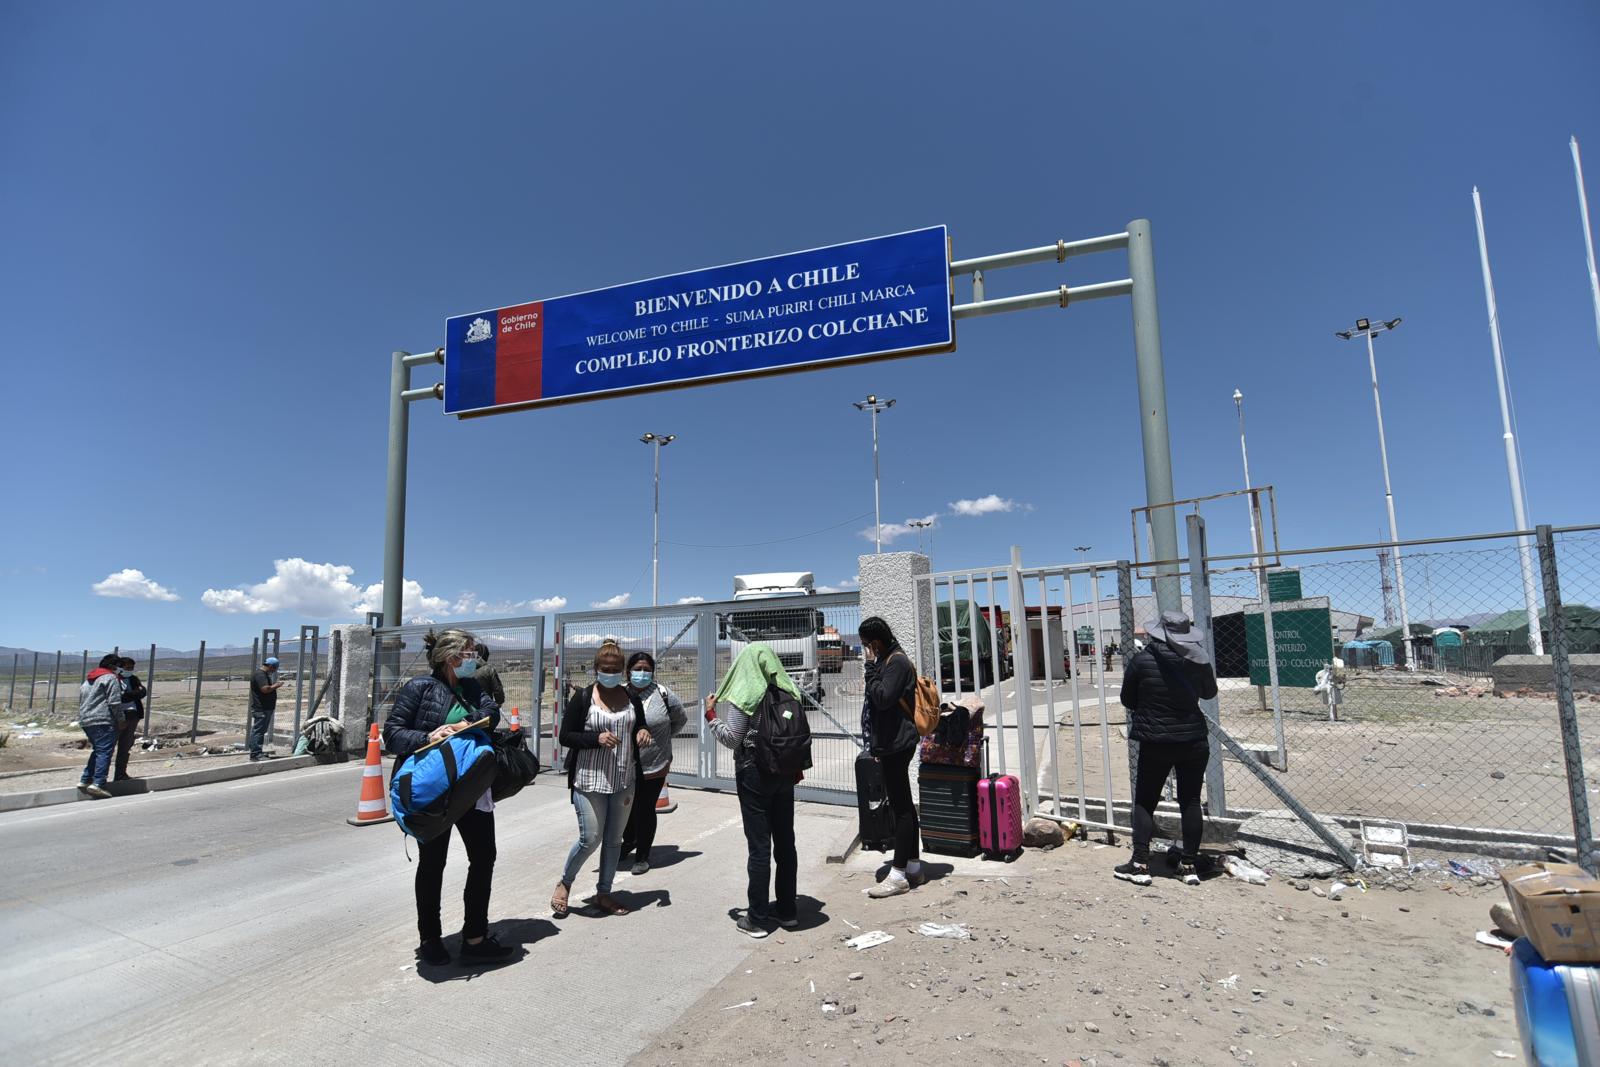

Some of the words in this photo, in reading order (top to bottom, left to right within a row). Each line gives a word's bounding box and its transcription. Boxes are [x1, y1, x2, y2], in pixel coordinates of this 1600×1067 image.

[634, 280, 762, 317] BIENVENIDO
[767, 277, 783, 294] A
[787, 262, 860, 290] CHILE
[501, 312, 538, 325] Gobierno
[502, 325, 513, 333] de
[515, 321, 536, 331] Chile
[586, 328, 647, 347] WELCOME
[651, 324, 667, 337] TO
[671, 317, 709, 333] CHILE
[725, 309, 765, 325] SUMA
[768, 300, 813, 318] PURIRI
[818, 292, 856, 310] CHILI
[861, 284, 916, 303] MARCA
[575, 347, 672, 375] COMPLEJO
[676, 327, 803, 360] FRONTERIZO
[808, 307, 929, 340] COLCHANE
[1273, 630, 1301, 639] ONTROL
